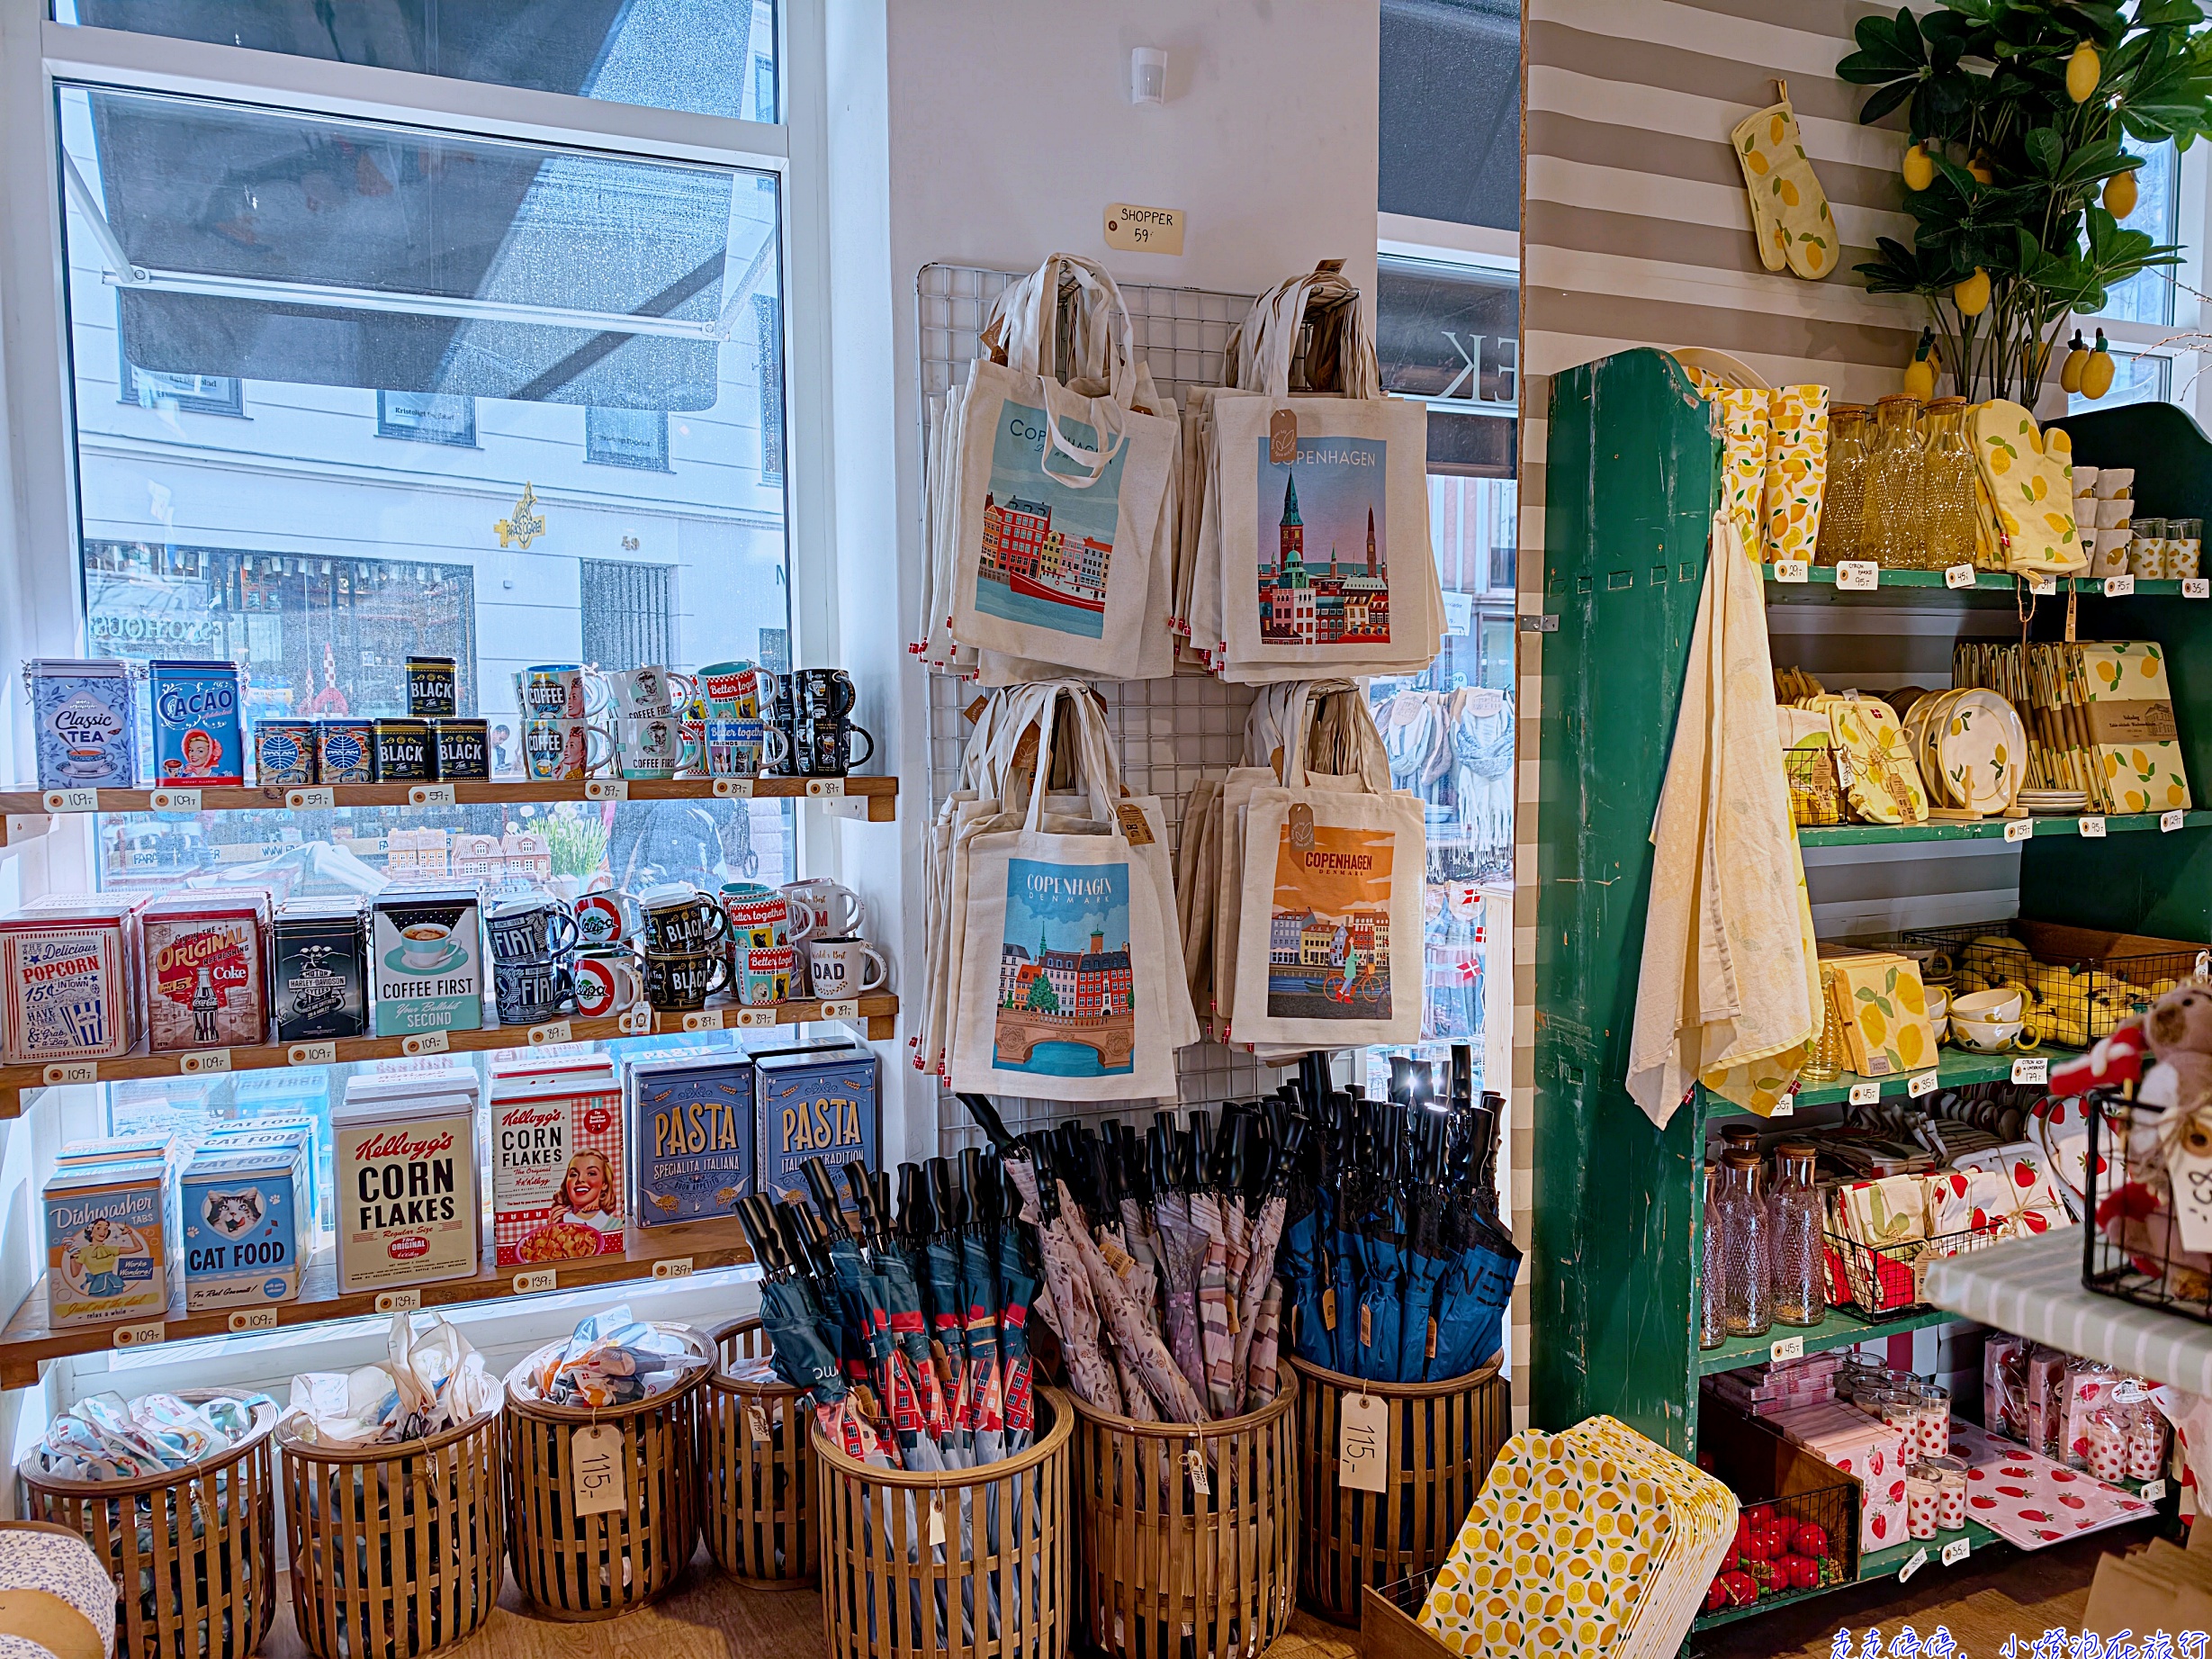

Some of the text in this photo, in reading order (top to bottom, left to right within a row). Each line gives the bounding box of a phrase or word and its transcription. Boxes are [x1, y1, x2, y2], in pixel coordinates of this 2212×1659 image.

[1120, 208, 1173, 226] SHOPPER
[1271, 450, 1376, 467] PENHAGEN
[410, 682, 452, 699] BLACK
[528, 687, 564, 704] COFFEE
[710, 684, 737, 696] Better
[157, 689, 233, 724] CACAO
[55, 710, 112, 731] Classic
[67, 730, 104, 743] TEA
[711, 726, 736, 737] Better
[527, 735, 561, 752] COFFEE
[263, 749, 296, 757] PAN AM
[327, 749, 360, 757] PAN AM
[380, 745, 424, 762] BLACK
[439, 744, 482, 761] BLACK
[633, 758, 659, 769] COFFEE
[1305, 851, 1373, 871] COPENHAGEN
[1318, 869, 1365, 877] DENMARK
[1027, 872, 1112, 896] COPENHAGEN
[813, 895, 827, 904] Best
[1028, 890, 1110, 905] DENMARK
[577, 913, 619, 933] Vespa
[731, 908, 786, 923] Better together
[174, 925, 216, 947] Enjoy THE
[666, 918, 703, 942] BLACK
[156, 926, 248, 972] ORIGINAL
[493, 926, 534, 958] FIAT
[42, 943, 98, 960] Delicious
[202, 944, 249, 966] REFRESHING
[832, 951, 848, 960] Best
[22, 955, 100, 985] POPCORN
[751, 956, 776, 968] Better
[212, 966, 247, 980] Coke
[672, 969, 707, 990] BLACK
[813, 962, 845, 980] DAD
[58, 980, 67, 988] IN
[67, 979, 89, 987] TOWN
[175, 978, 187, 991] 5
[290, 977, 345, 987] HARLEY-DAVIDSON
[382, 978, 473, 999] COFFEE FIRST
[306, 987, 329, 996] CYCLES
[522, 977, 554, 1005] FIAT
[27, 1007, 56, 1022] HAVE
[395, 1000, 463, 1019] Your Bullshit
[407, 1012, 452, 1028] SECOND
[40, 1028, 67, 1041] Grab
[49, 1037, 69, 1047] Bag
[258, 1117, 310, 1126] FOOD
[501, 1108, 562, 1128] Kellogg's
[782, 1098, 863, 1153] PASTA
[501, 1126, 562, 1151] CORN
[654, 1103, 739, 1158] PASTA
[203, 1132, 301, 1147] CAT FOOD
[355, 1131, 454, 1162] Kellogg's
[190, 1154, 292, 1169] CAT FOOD
[502, 1148, 562, 1168] FLAKES
[703, 1155, 740, 1172] ITALIANA
[526, 1166, 552, 1175] Original
[358, 1158, 454, 1204] CORN
[674, 1177, 720, 1191] BUON APPETITO
[49, 1194, 153, 1230] Dishwasher
[130, 1213, 154, 1226] TABS
[360, 1196, 454, 1231] FLAKES
[382, 1226, 434, 1239] Regular Size
[391, 1240, 426, 1251] ORIGINAL
[124, 1260, 148, 1269] Works
[189, 1241, 285, 1271] CAT FOOD
[119, 1267, 153, 1277] Wonders!
[193, 1291, 204, 1299] For
[205, 1289, 221, 1298] Real
[61, 1302, 90, 1319] Just
[86, 1312, 103, 1320] relax
[110, 1309, 127, 1317] while
[1342, 1425, 1375, 1474] 115,-
[580, 1453, 611, 1499] 115,-
